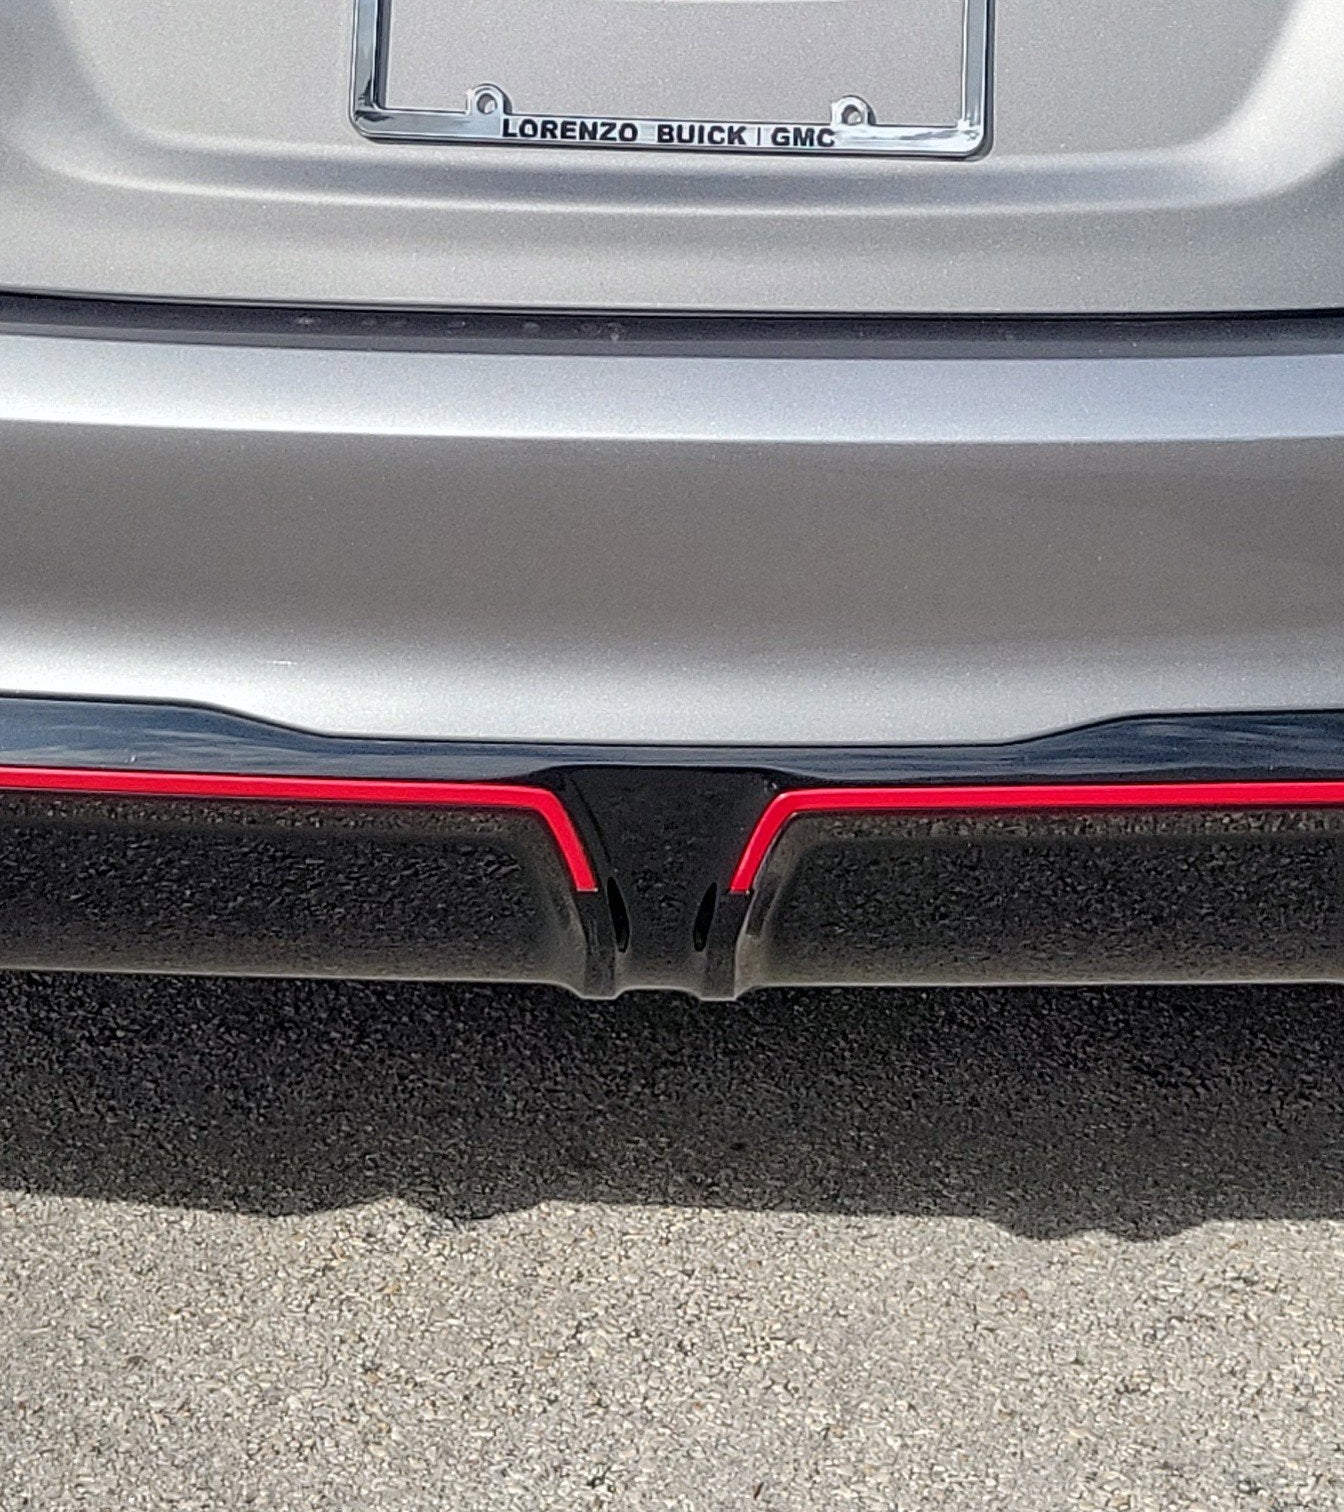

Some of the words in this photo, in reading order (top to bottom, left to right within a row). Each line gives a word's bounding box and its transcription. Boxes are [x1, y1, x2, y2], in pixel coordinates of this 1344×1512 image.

[502, 118, 638, 142] LORENZO
[657, 123, 747, 146] BUICK
[771, 126, 836, 147] GMC
